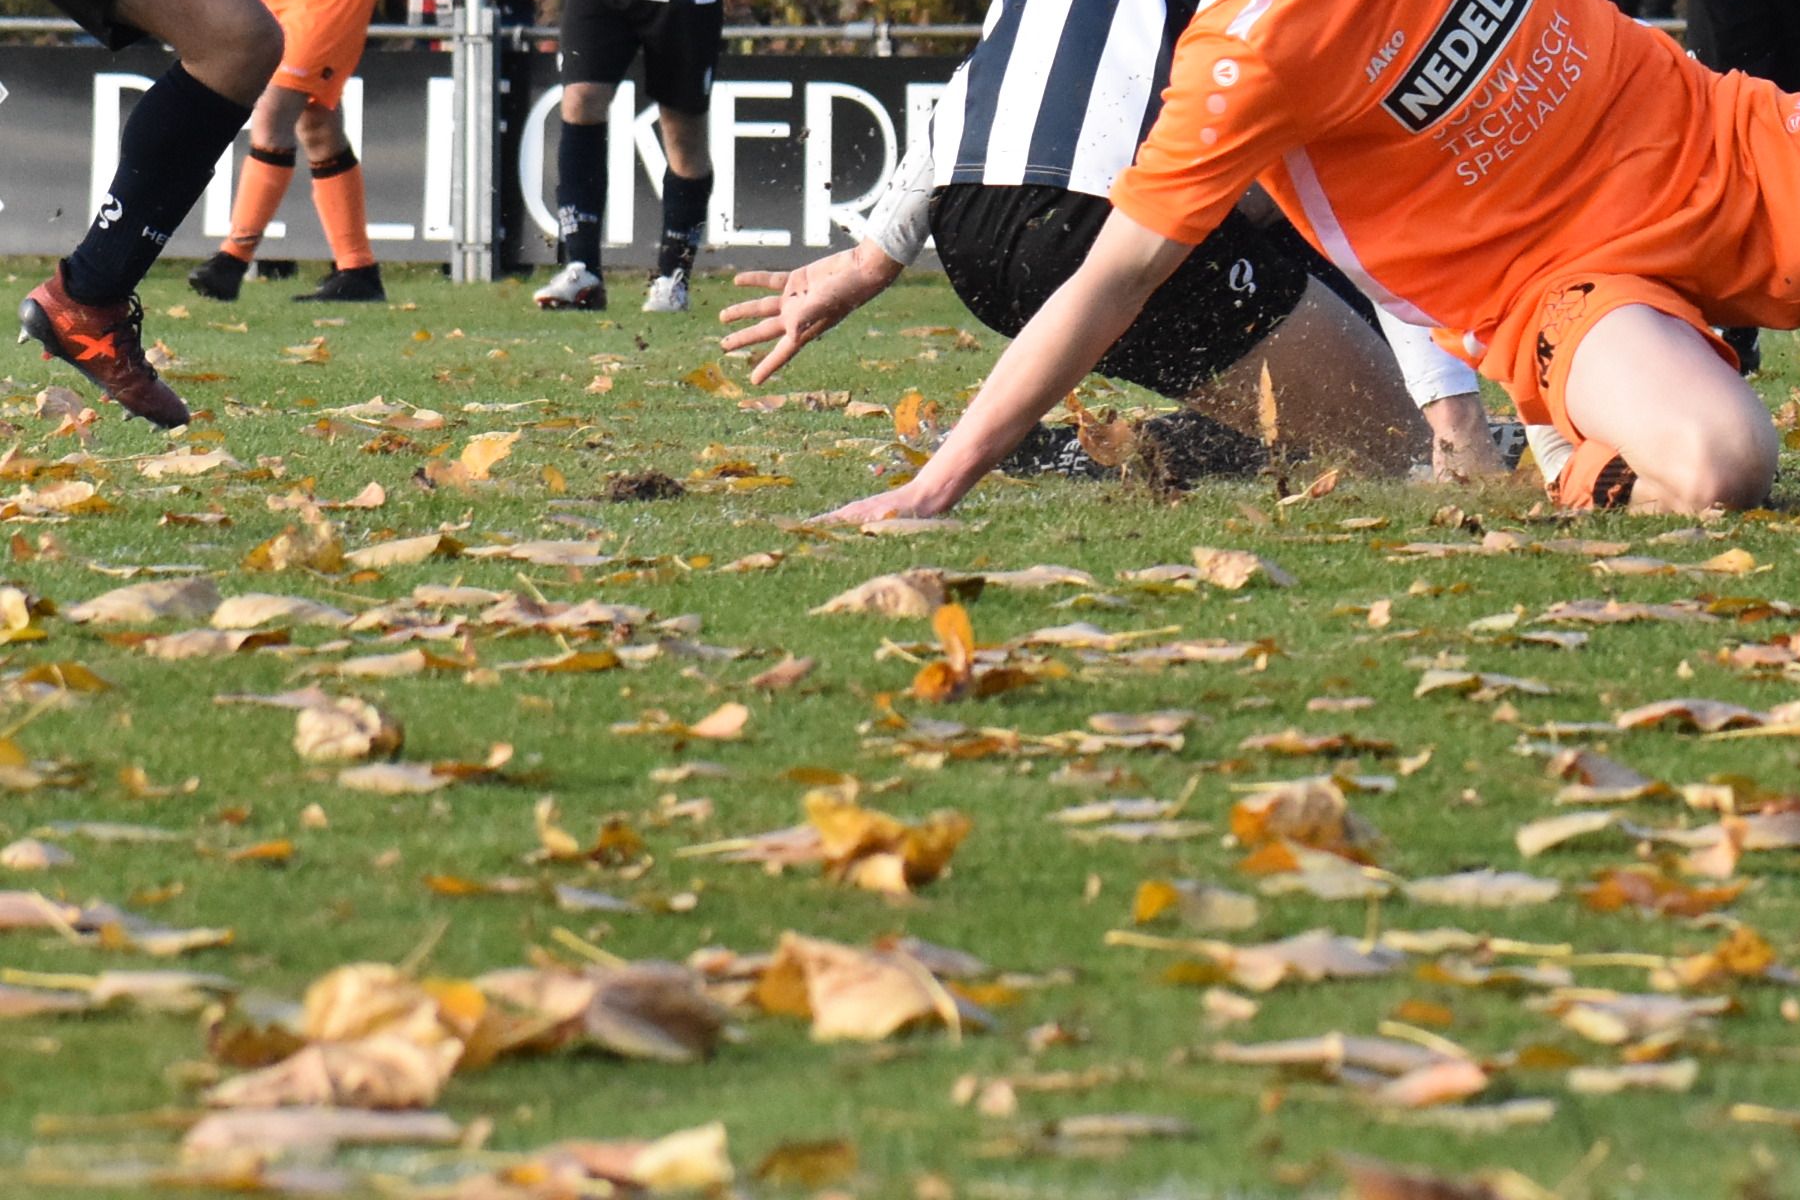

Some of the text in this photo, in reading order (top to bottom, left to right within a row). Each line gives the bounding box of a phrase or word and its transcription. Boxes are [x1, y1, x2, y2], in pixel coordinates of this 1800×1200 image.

[1365, 30, 1406, 83] JAKO
[1440, 8, 1571, 157] TECHNISCH
[1456, 37, 1589, 186] SPECIALIST
